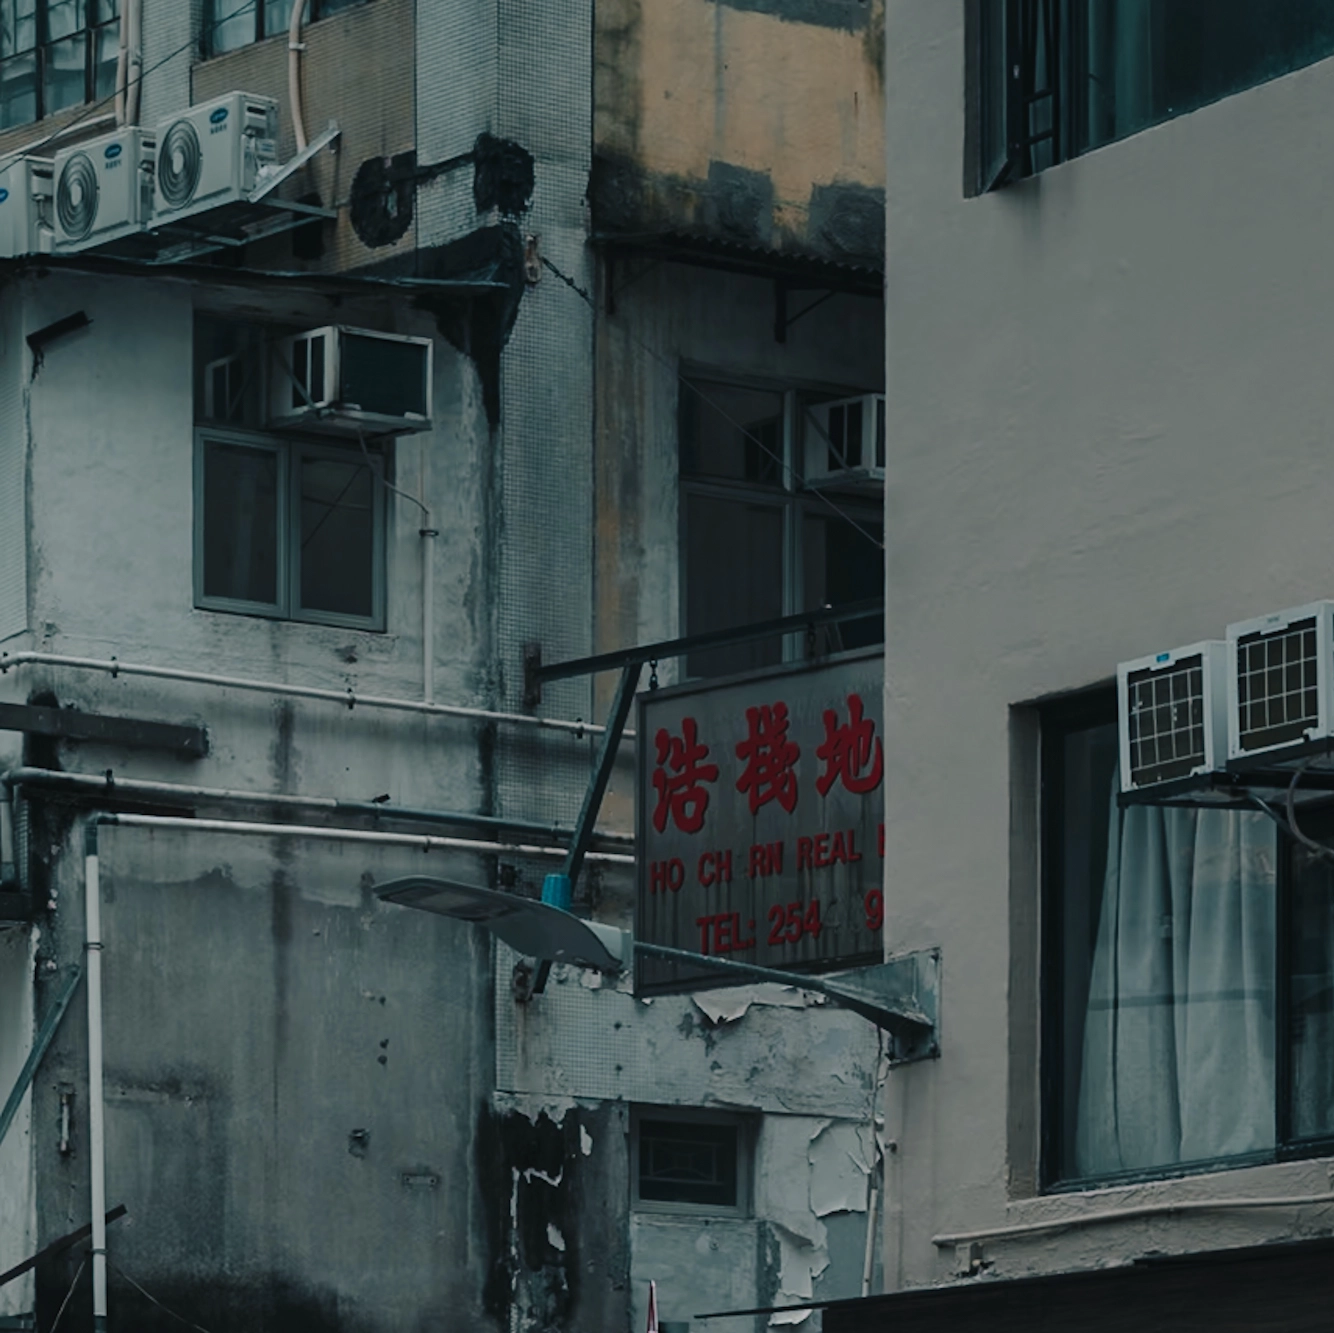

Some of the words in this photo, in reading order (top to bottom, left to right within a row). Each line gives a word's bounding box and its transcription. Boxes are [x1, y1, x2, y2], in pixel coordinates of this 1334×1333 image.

[650, 857, 685, 894] HO
[797, 829, 862, 871] REAL
[696, 911, 757, 955] TEL:
